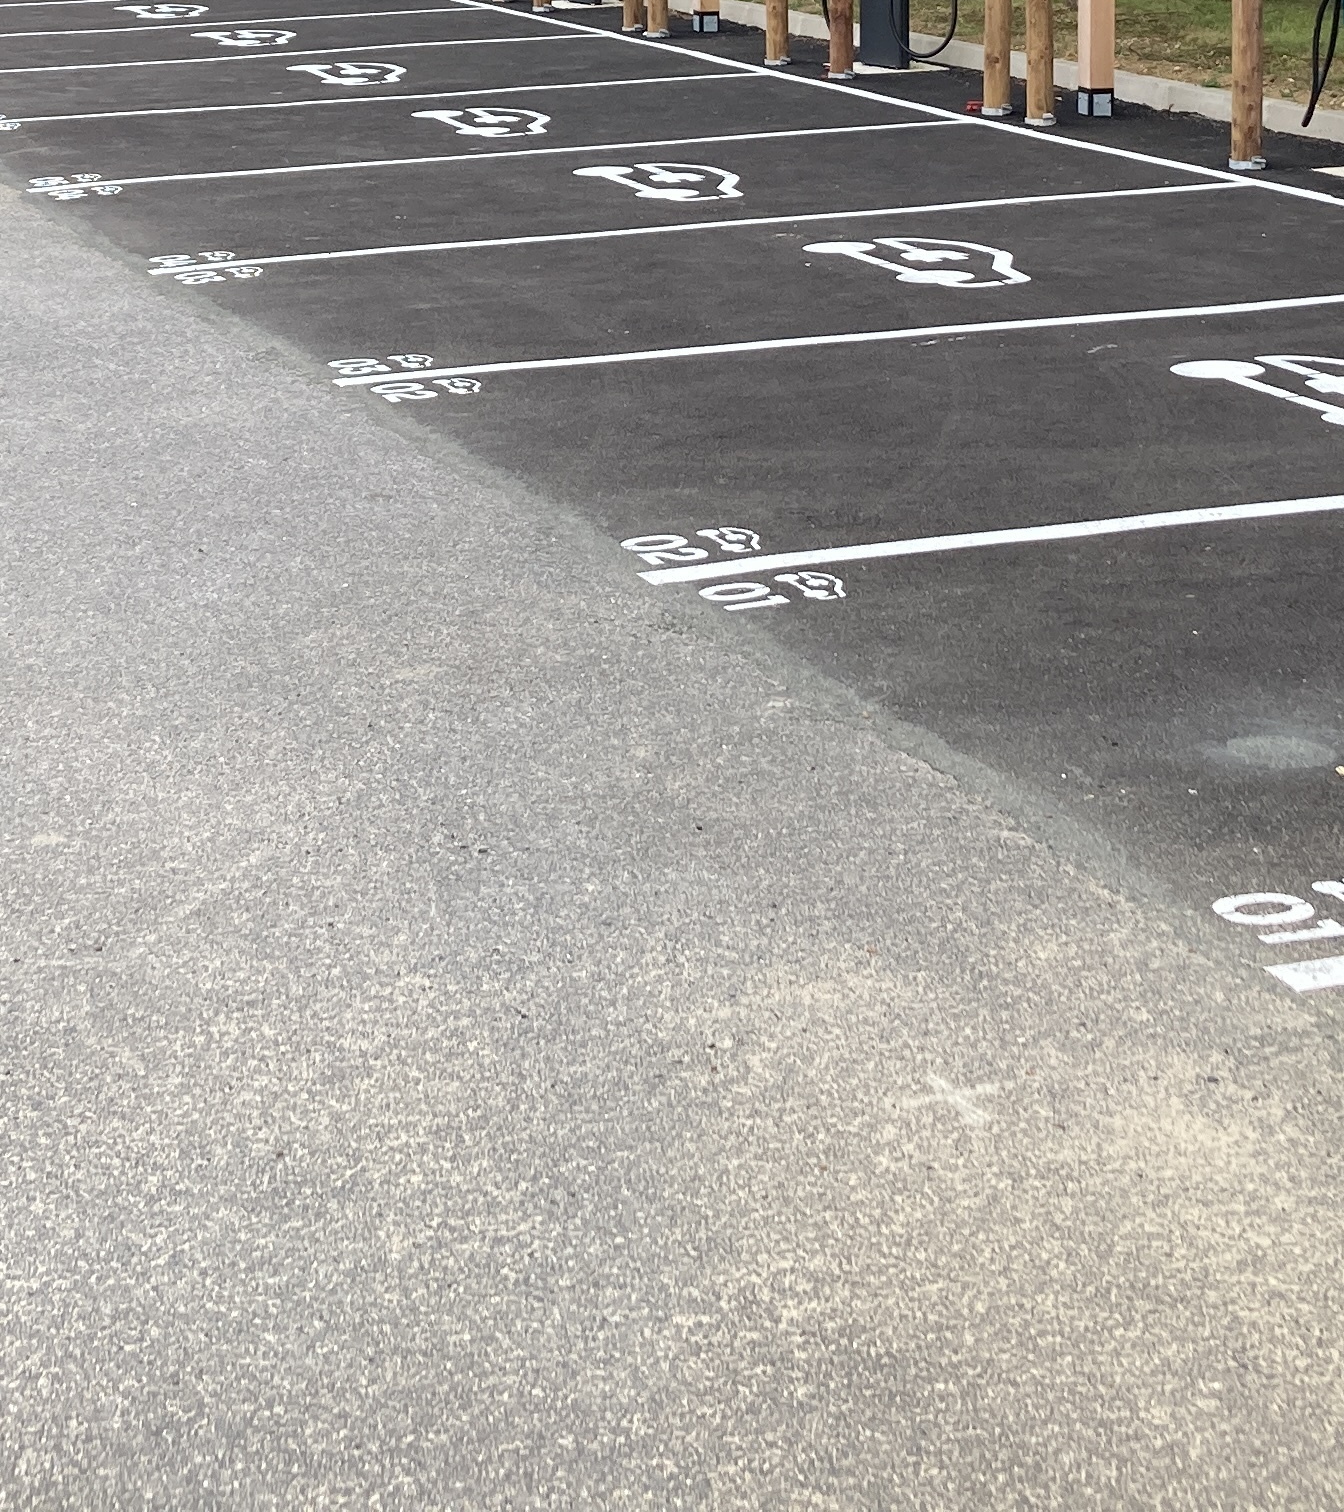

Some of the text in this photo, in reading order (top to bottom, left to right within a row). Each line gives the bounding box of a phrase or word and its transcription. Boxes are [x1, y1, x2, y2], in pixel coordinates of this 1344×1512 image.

[326, 357, 392, 375] 03
[370, 382, 438, 403] 02
[620, 534, 709, 566] 02
[698, 581, 791, 611] 01
